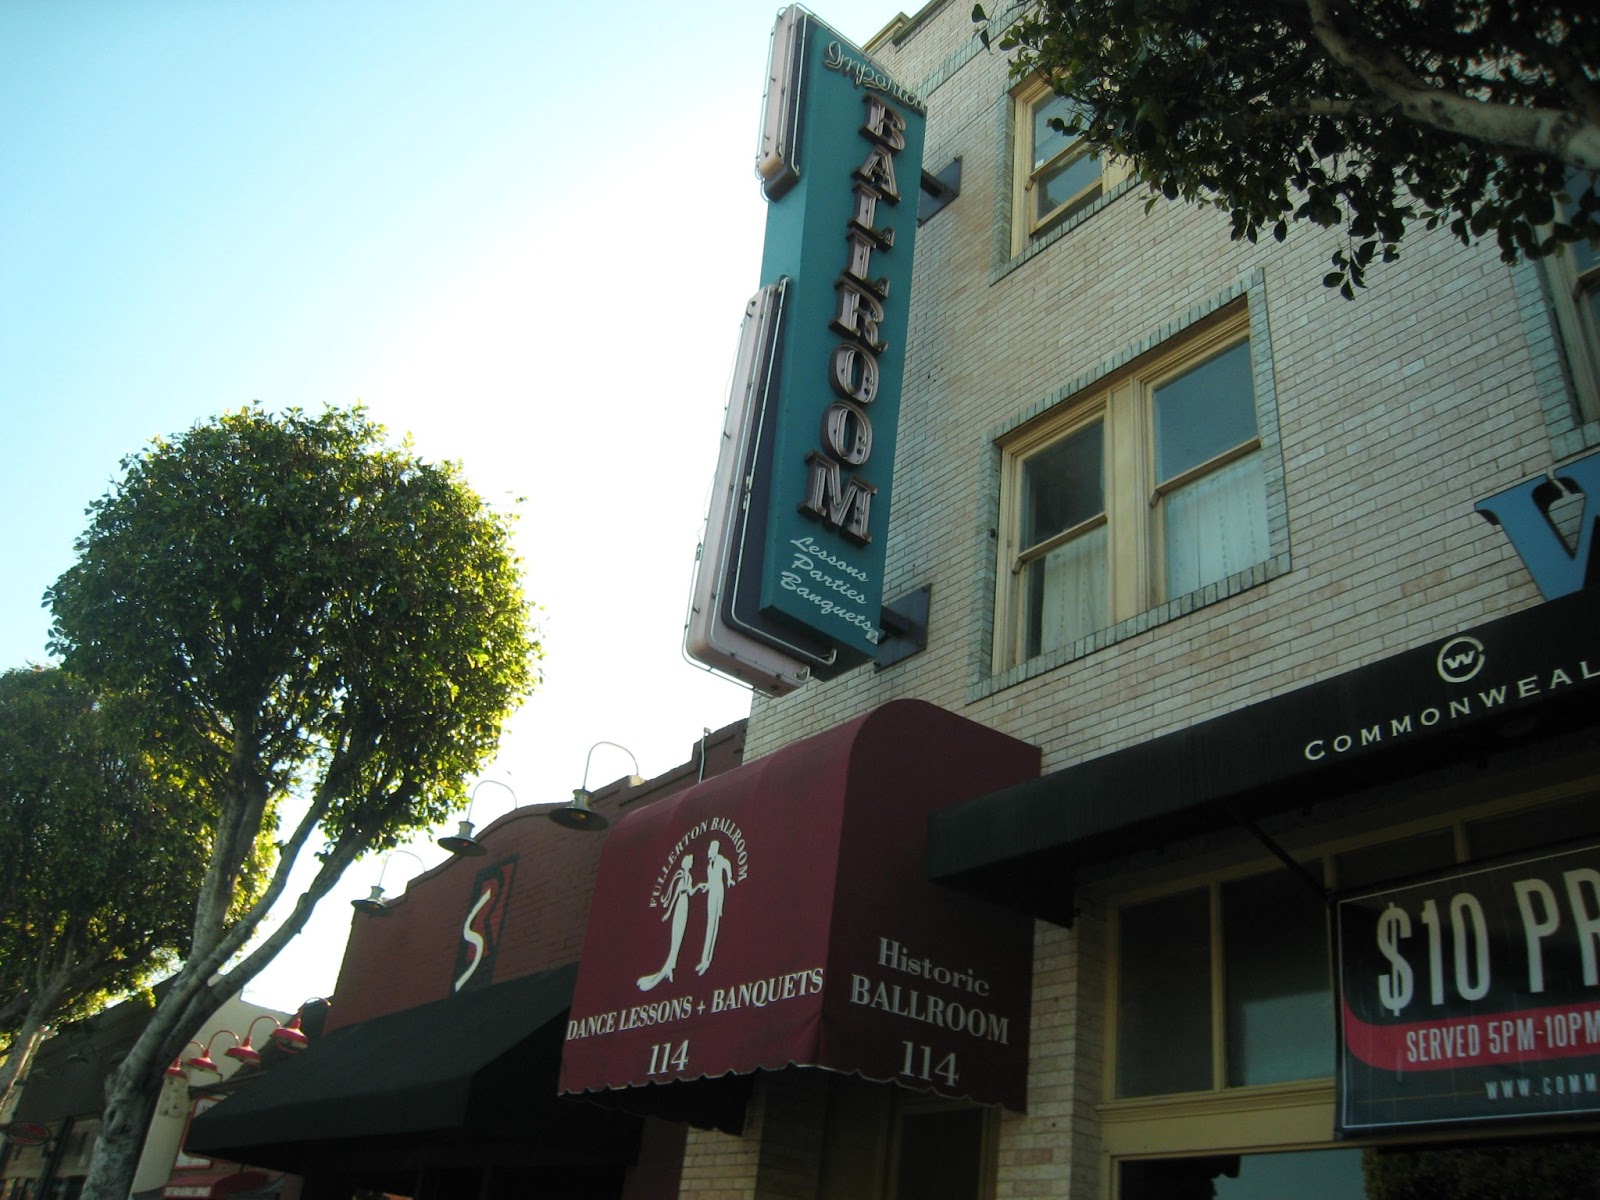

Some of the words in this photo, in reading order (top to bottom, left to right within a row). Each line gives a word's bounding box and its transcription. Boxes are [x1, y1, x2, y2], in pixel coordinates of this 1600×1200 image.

[797, 93, 906, 544] BALLROOM
[790, 537, 868, 582] Lessons
[792, 553, 867, 604] Parties
[780, 571, 872, 632] Banquets
[1304, 660, 1600, 760] COMMONWEAL
[649, 820, 708, 908] FULLERTON
[710, 817, 748, 882] BALLROOM
[878, 937, 990, 996] Historic
[1377, 893, 1491, 1017] $10
[566, 1011, 617, 1040] DANCE
[618, 996, 693, 1032] LESSONS
[711, 968, 825, 1013] BANQUETS
[851, 974, 1009, 1045] BALLROOM
[647, 1040, 689, 1075] 114
[900, 1040, 959, 1087] 114
[1406, 1024, 1481, 1063] SERVED
